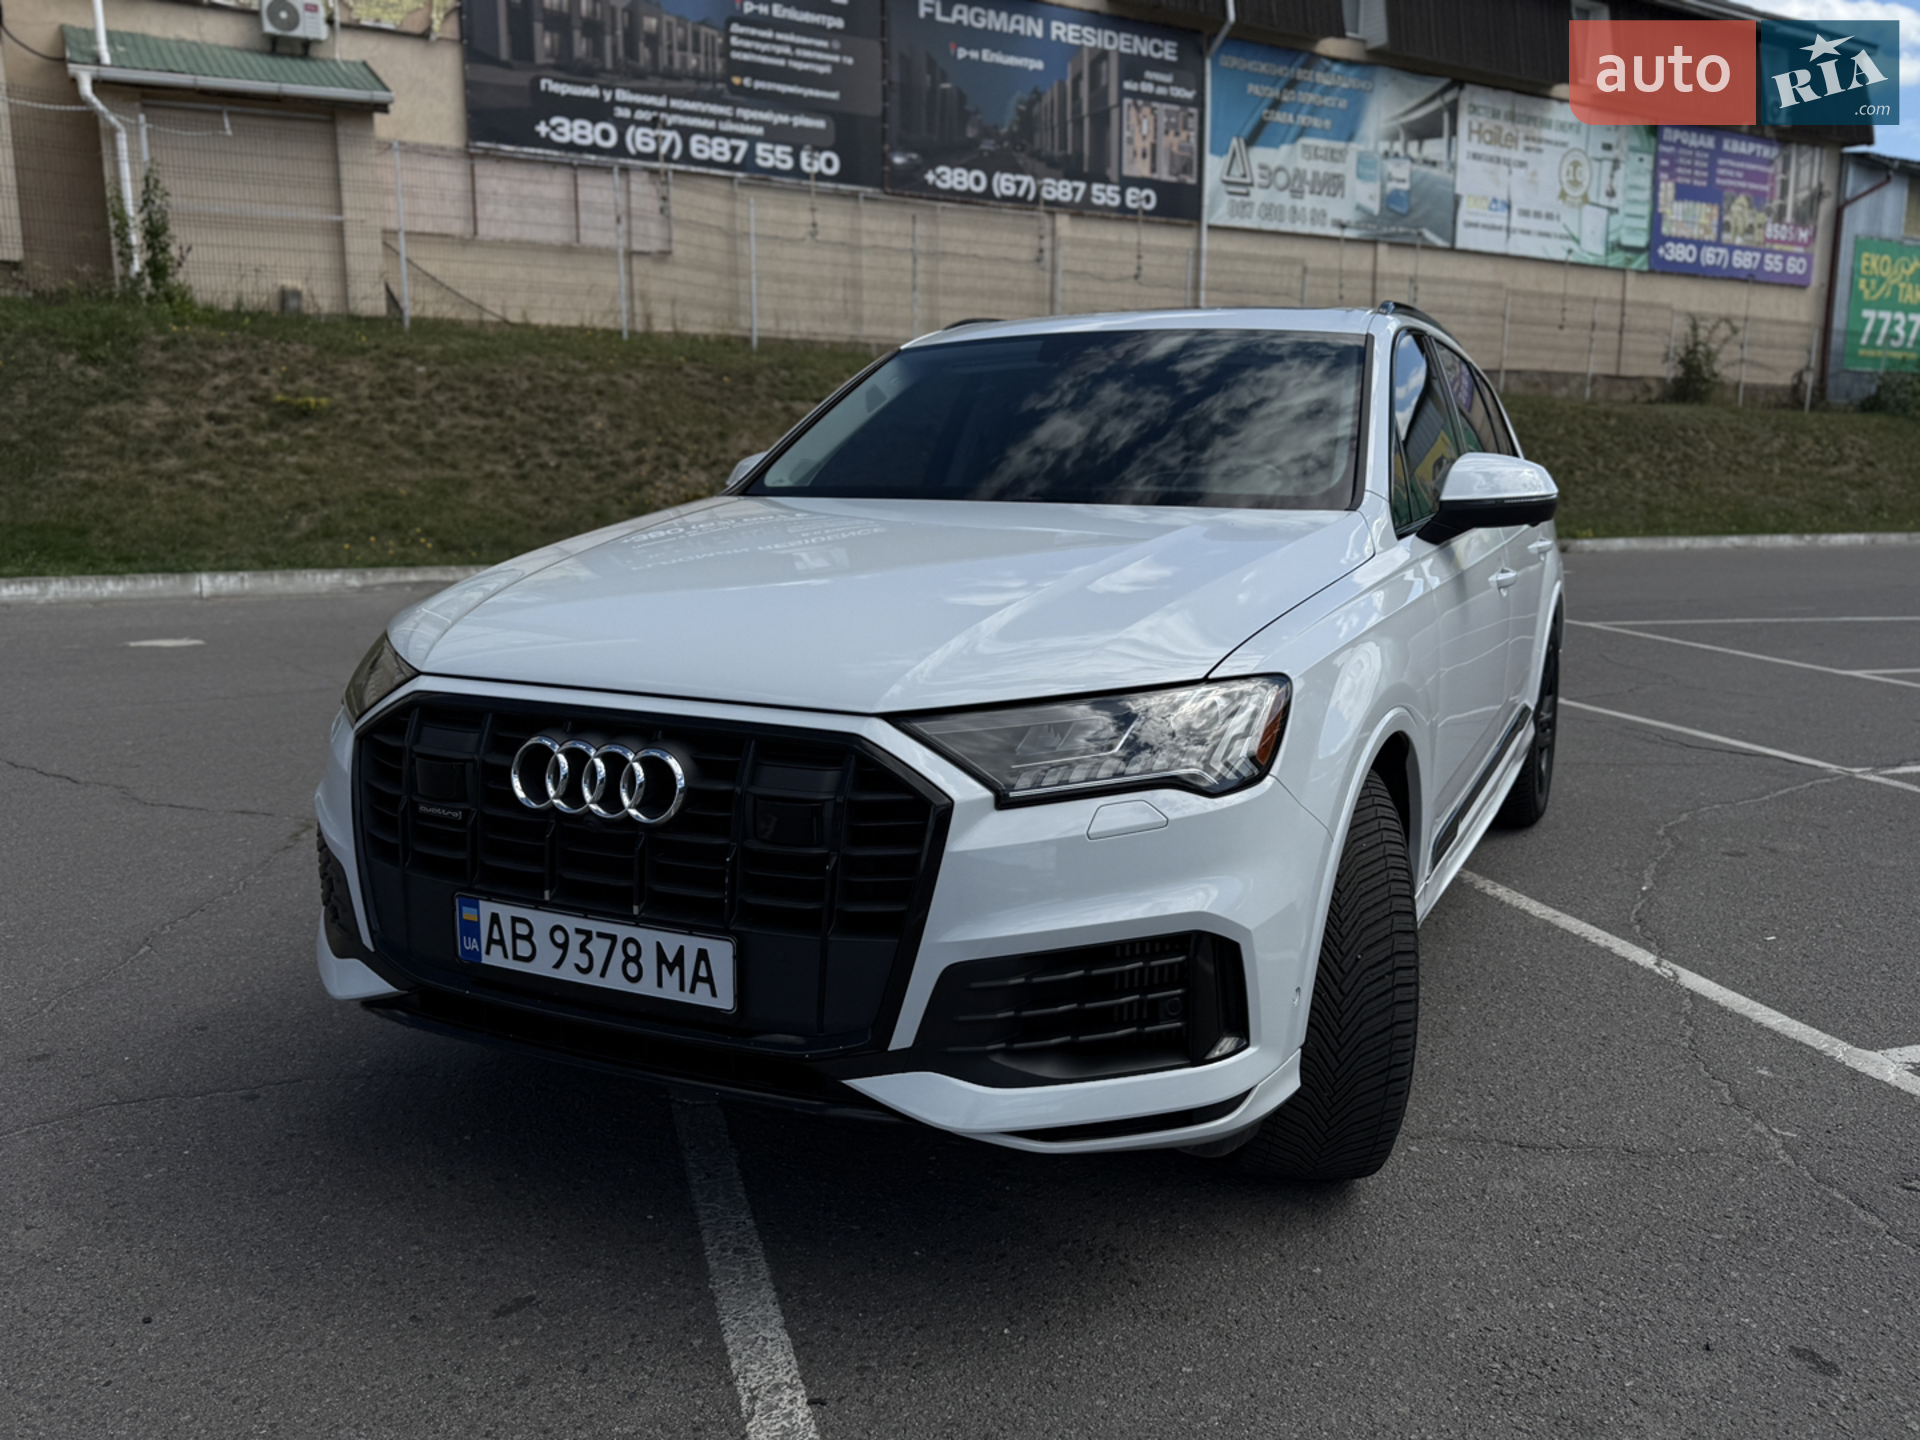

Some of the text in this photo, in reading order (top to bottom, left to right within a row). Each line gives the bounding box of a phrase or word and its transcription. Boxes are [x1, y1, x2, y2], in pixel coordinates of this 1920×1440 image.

[918, 0, 1179, 62] FLAGMAN RESIDENCE
[539, 77, 600, 98] Перший
[614, 88, 668, 108] Вінниці
[534, 115, 840, 176] +380 (67) 687 55 60
[1662, 127, 1716, 150] ПРОДАЖ
[923, 165, 1157, 210] +380 (67) 687 55 60
[1657, 242, 1807, 276] +380 (67) 687 55 60
[1860, 308, 1920, 349] 7737
[463, 935, 480, 952] UA
[484, 912, 718, 998] AB 9378 MA
